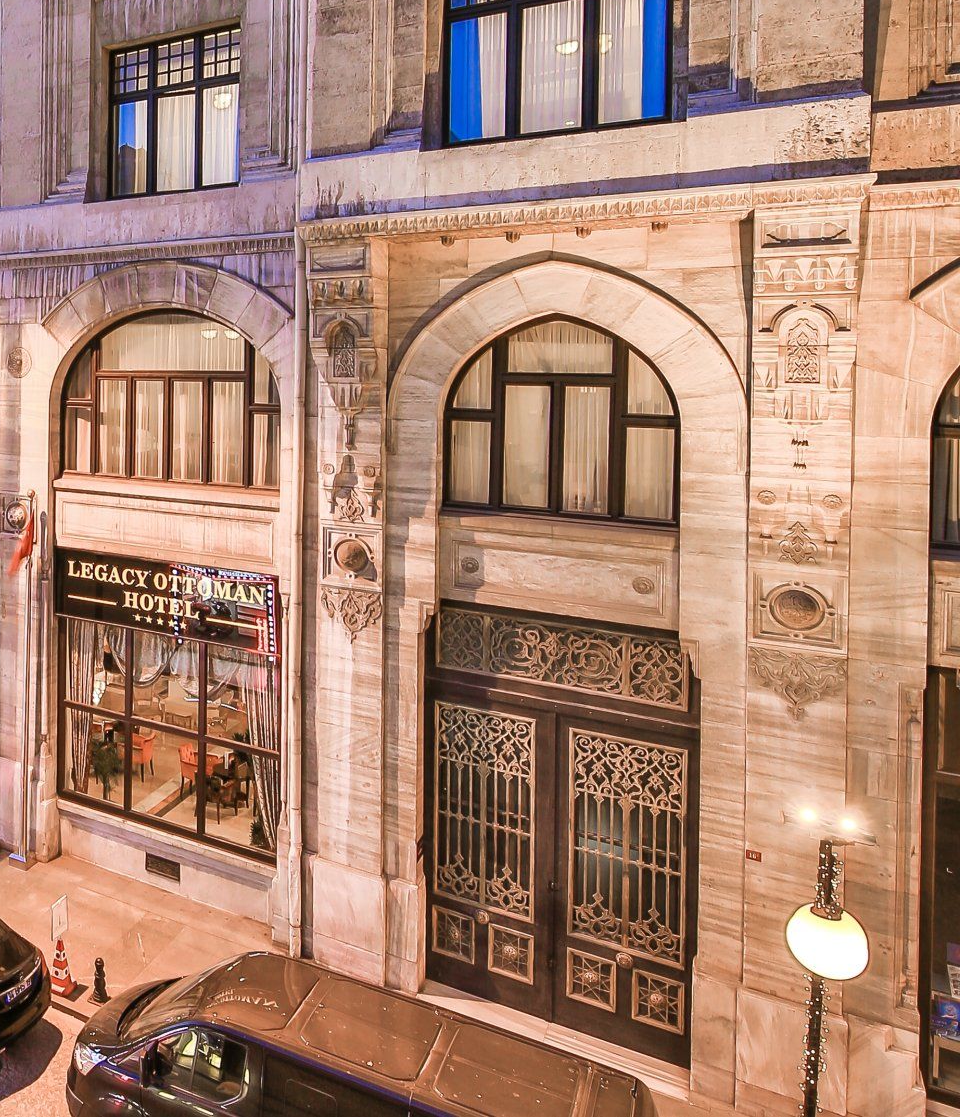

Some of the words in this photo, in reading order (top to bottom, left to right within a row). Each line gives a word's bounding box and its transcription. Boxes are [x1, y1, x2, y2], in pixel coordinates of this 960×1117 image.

[67, 560, 150, 589] LEGACY
[153, 572, 266, 606] OTTOMAN
[122, 591, 200, 620] HOTEL
